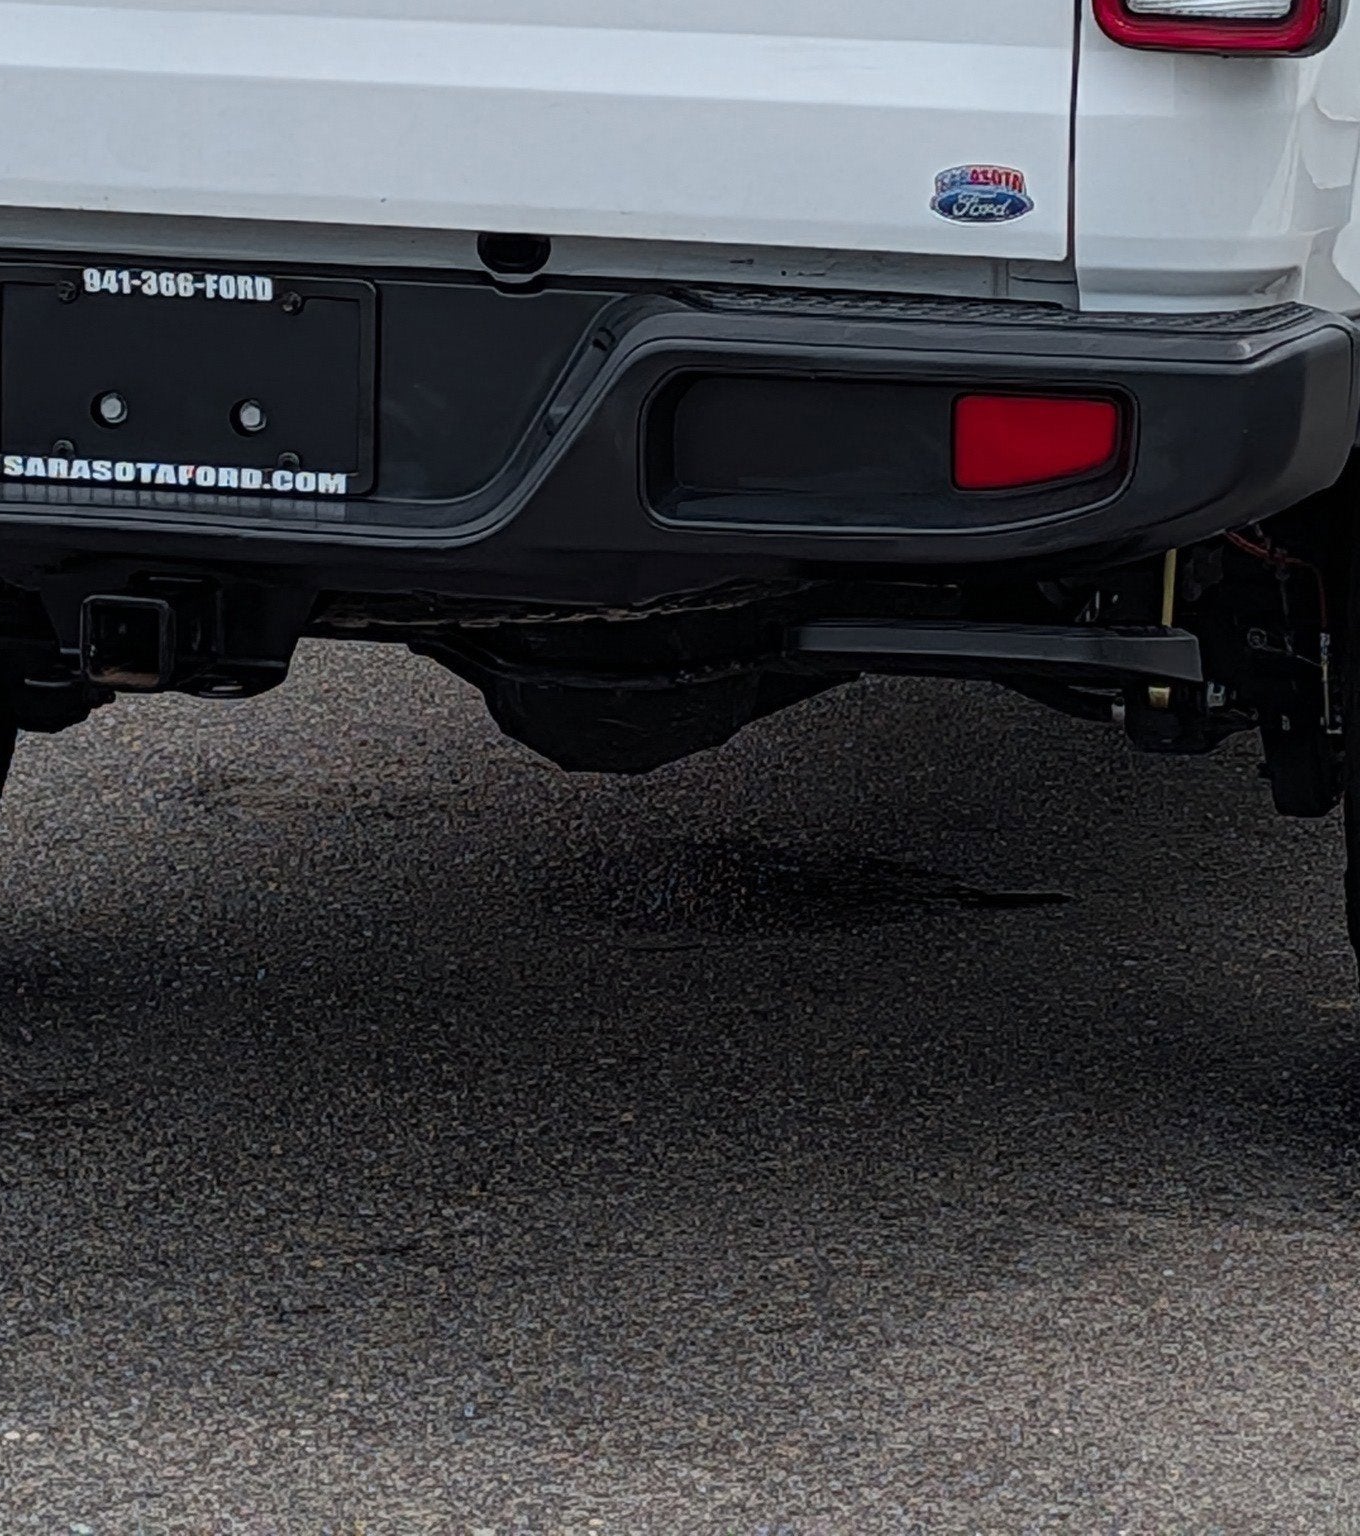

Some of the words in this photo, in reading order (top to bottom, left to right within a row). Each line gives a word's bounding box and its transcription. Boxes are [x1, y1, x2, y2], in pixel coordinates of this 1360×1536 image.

[952, 193, 1012, 217] Ford
[82, 267, 274, 302] 941-366-FORD
[3, 455, 347, 495] SARASOTAFORD.COM
